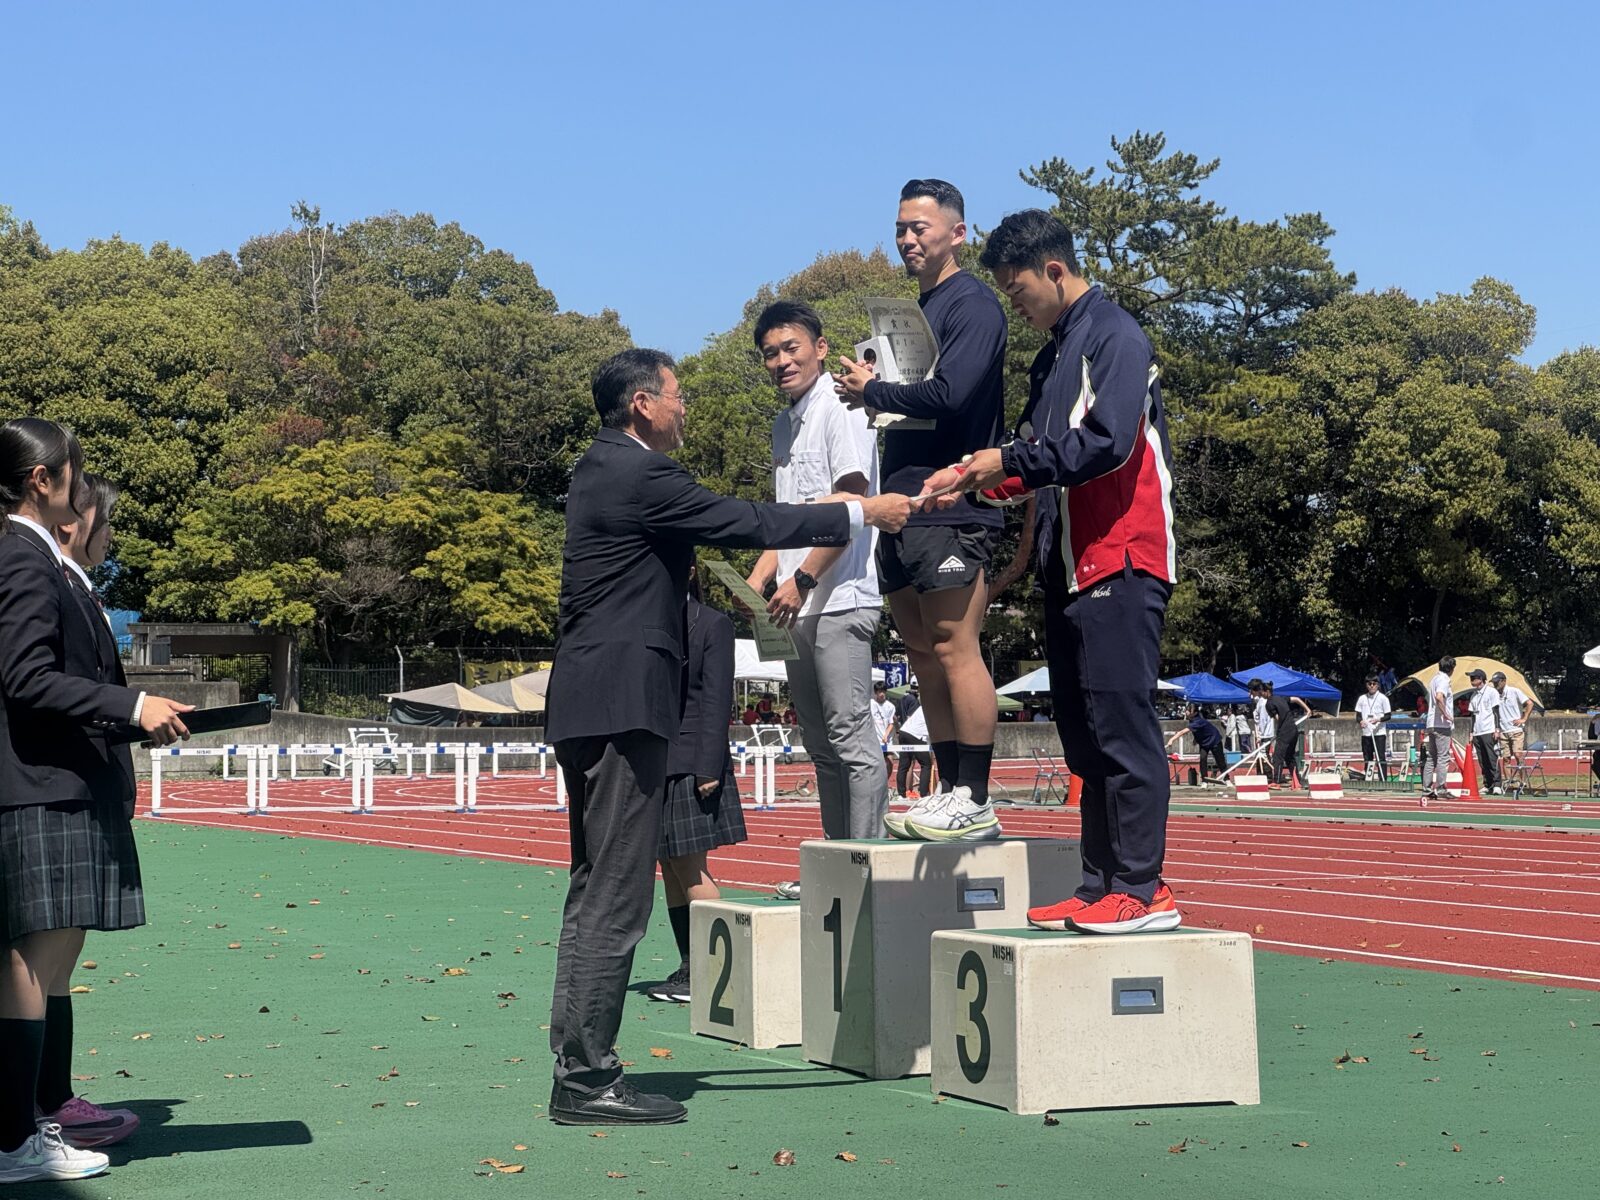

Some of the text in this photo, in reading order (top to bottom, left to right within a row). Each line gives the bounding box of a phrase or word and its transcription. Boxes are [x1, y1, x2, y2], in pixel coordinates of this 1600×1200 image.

[1367, 765, 1373, 778] 5
[1400, 764, 1407, 775] 4
[1421, 797, 1428, 807] 9
[851, 852, 869, 865] NISHI
[735, 912, 751, 926] NISHI
[823, 898, 842, 1013] 1
[992, 945, 1014, 962] NISHI
[709, 917, 734, 1027] 2
[956, 950, 991, 1084] 3
